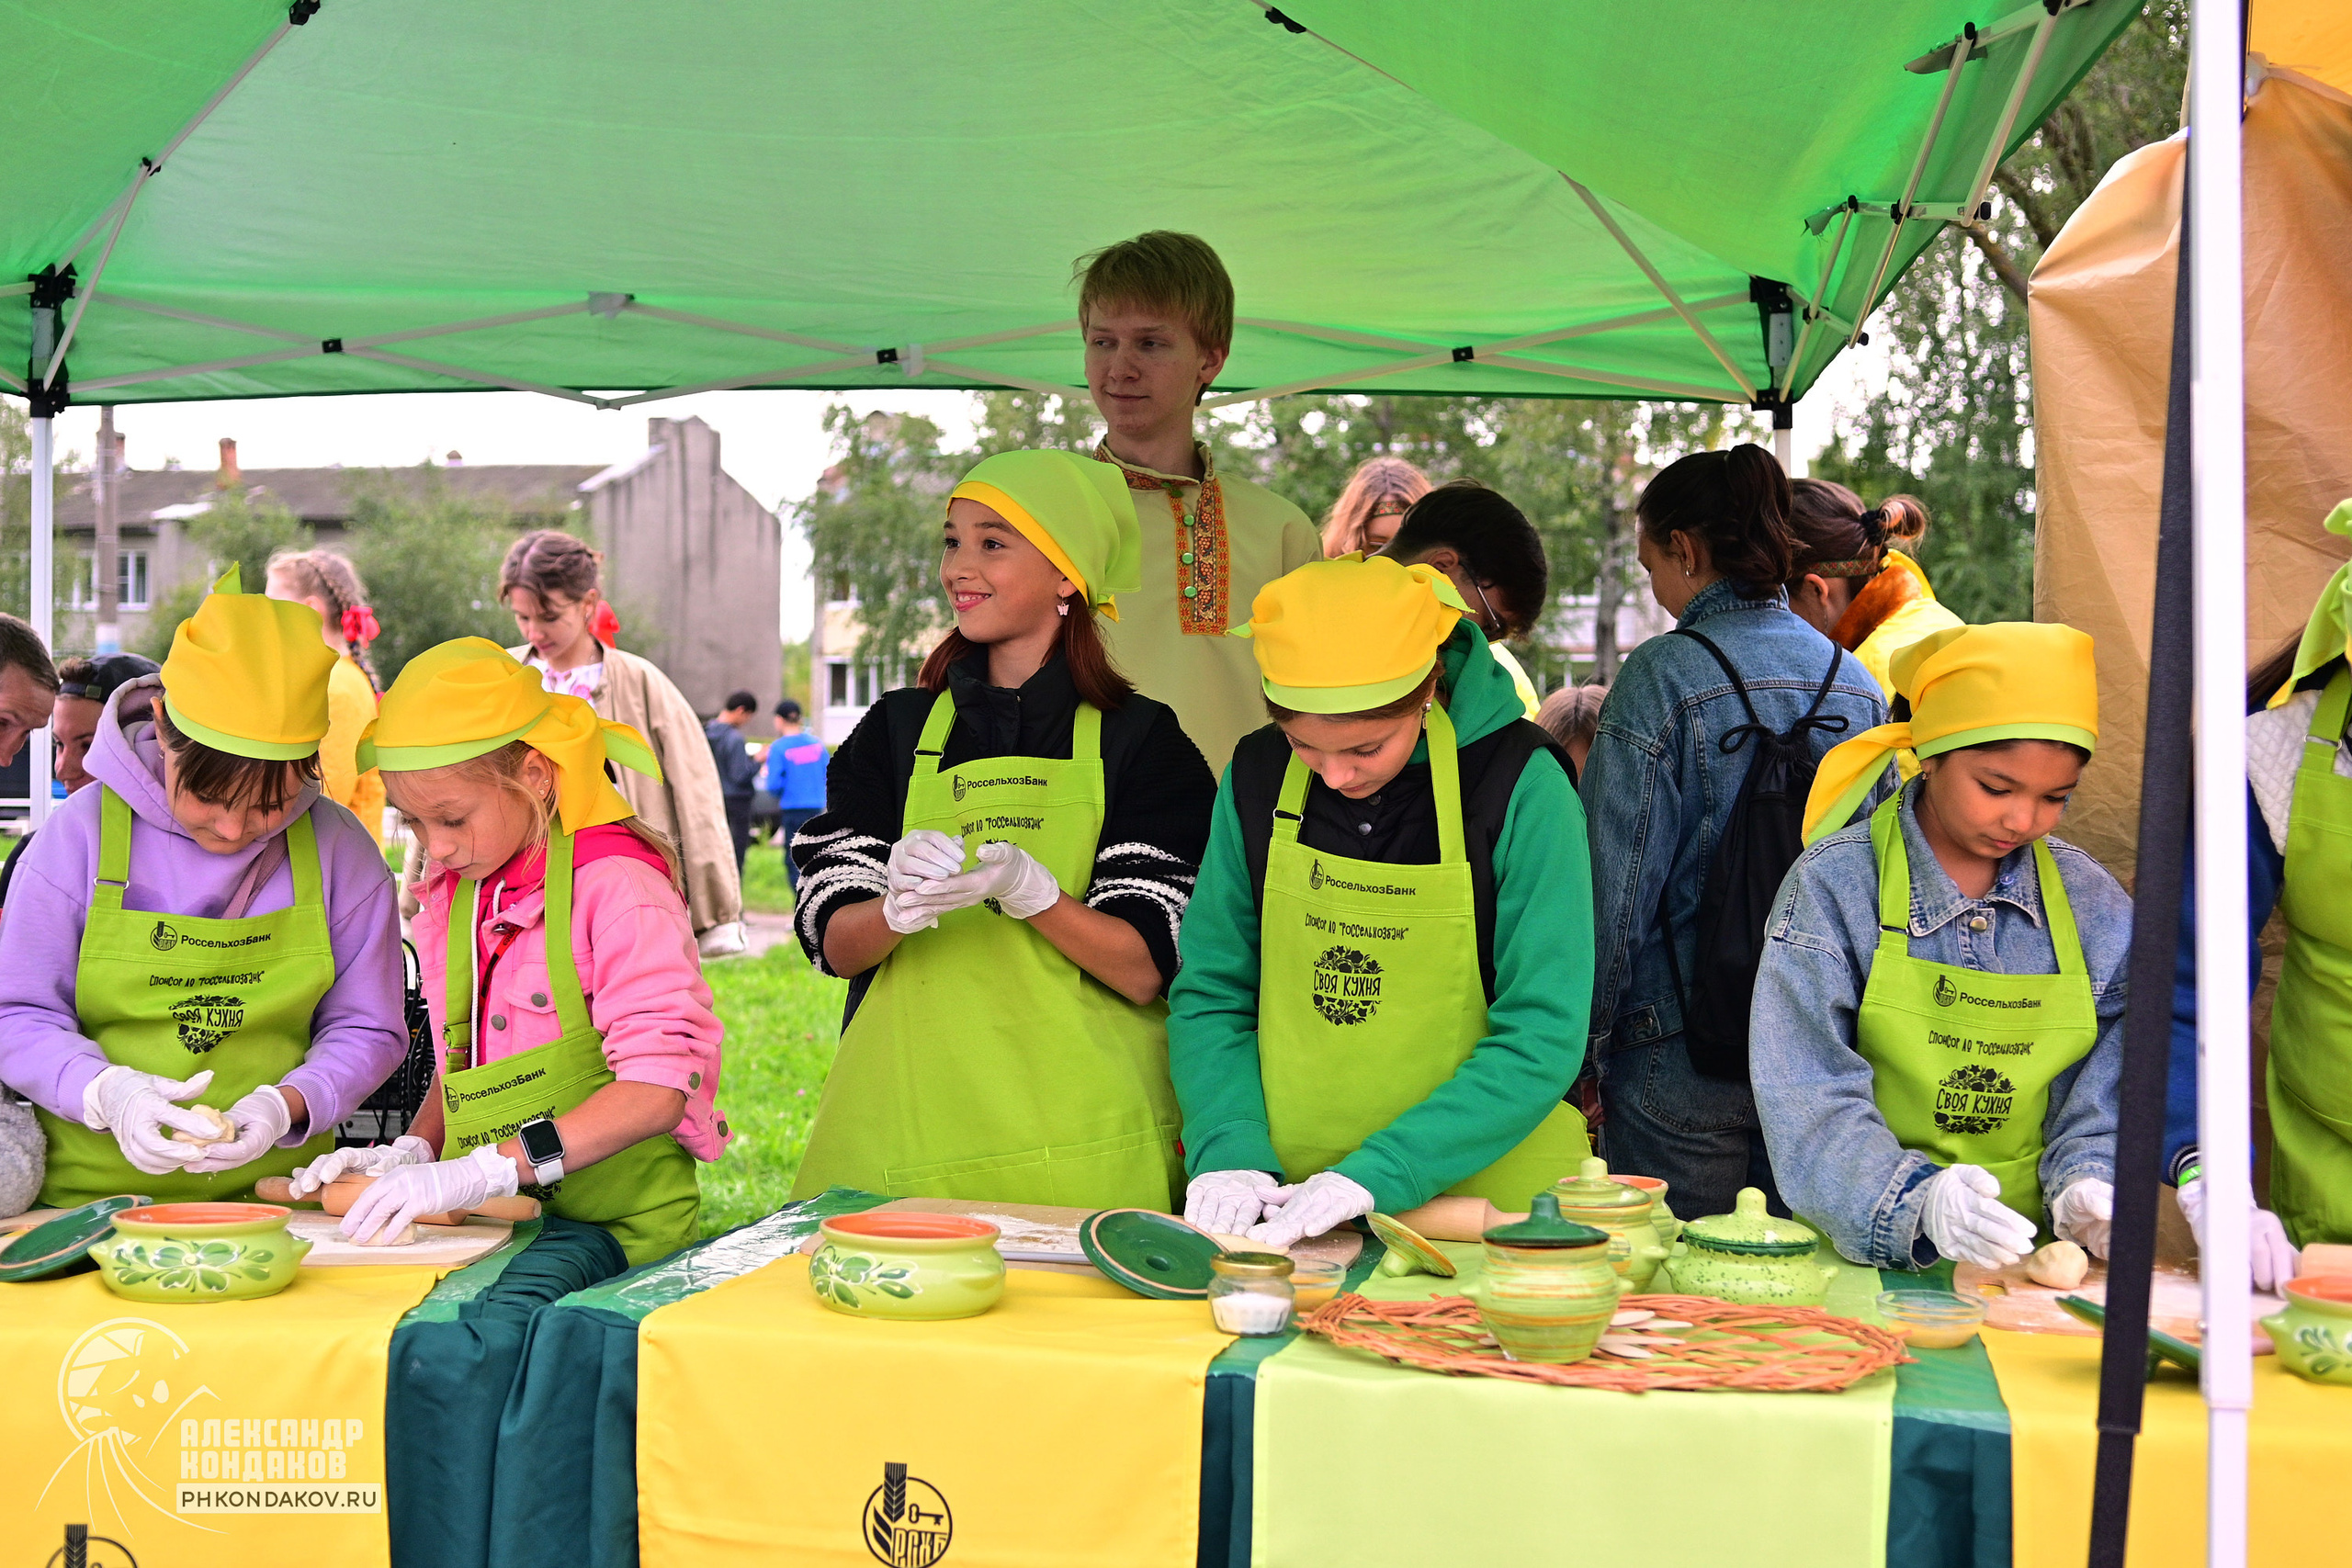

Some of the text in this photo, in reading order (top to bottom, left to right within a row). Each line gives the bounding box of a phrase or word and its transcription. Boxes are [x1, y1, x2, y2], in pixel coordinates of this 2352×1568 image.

[967, 775, 1048, 790] РоссельхозБанк
[1325, 874, 1416, 896] РоссельхозБанк
[180, 932, 272, 949] РоссельхозБанк
[1959, 992, 2041, 1009] РоссельхозБанк
[459, 1067, 547, 1103] РоссельхозБанк
